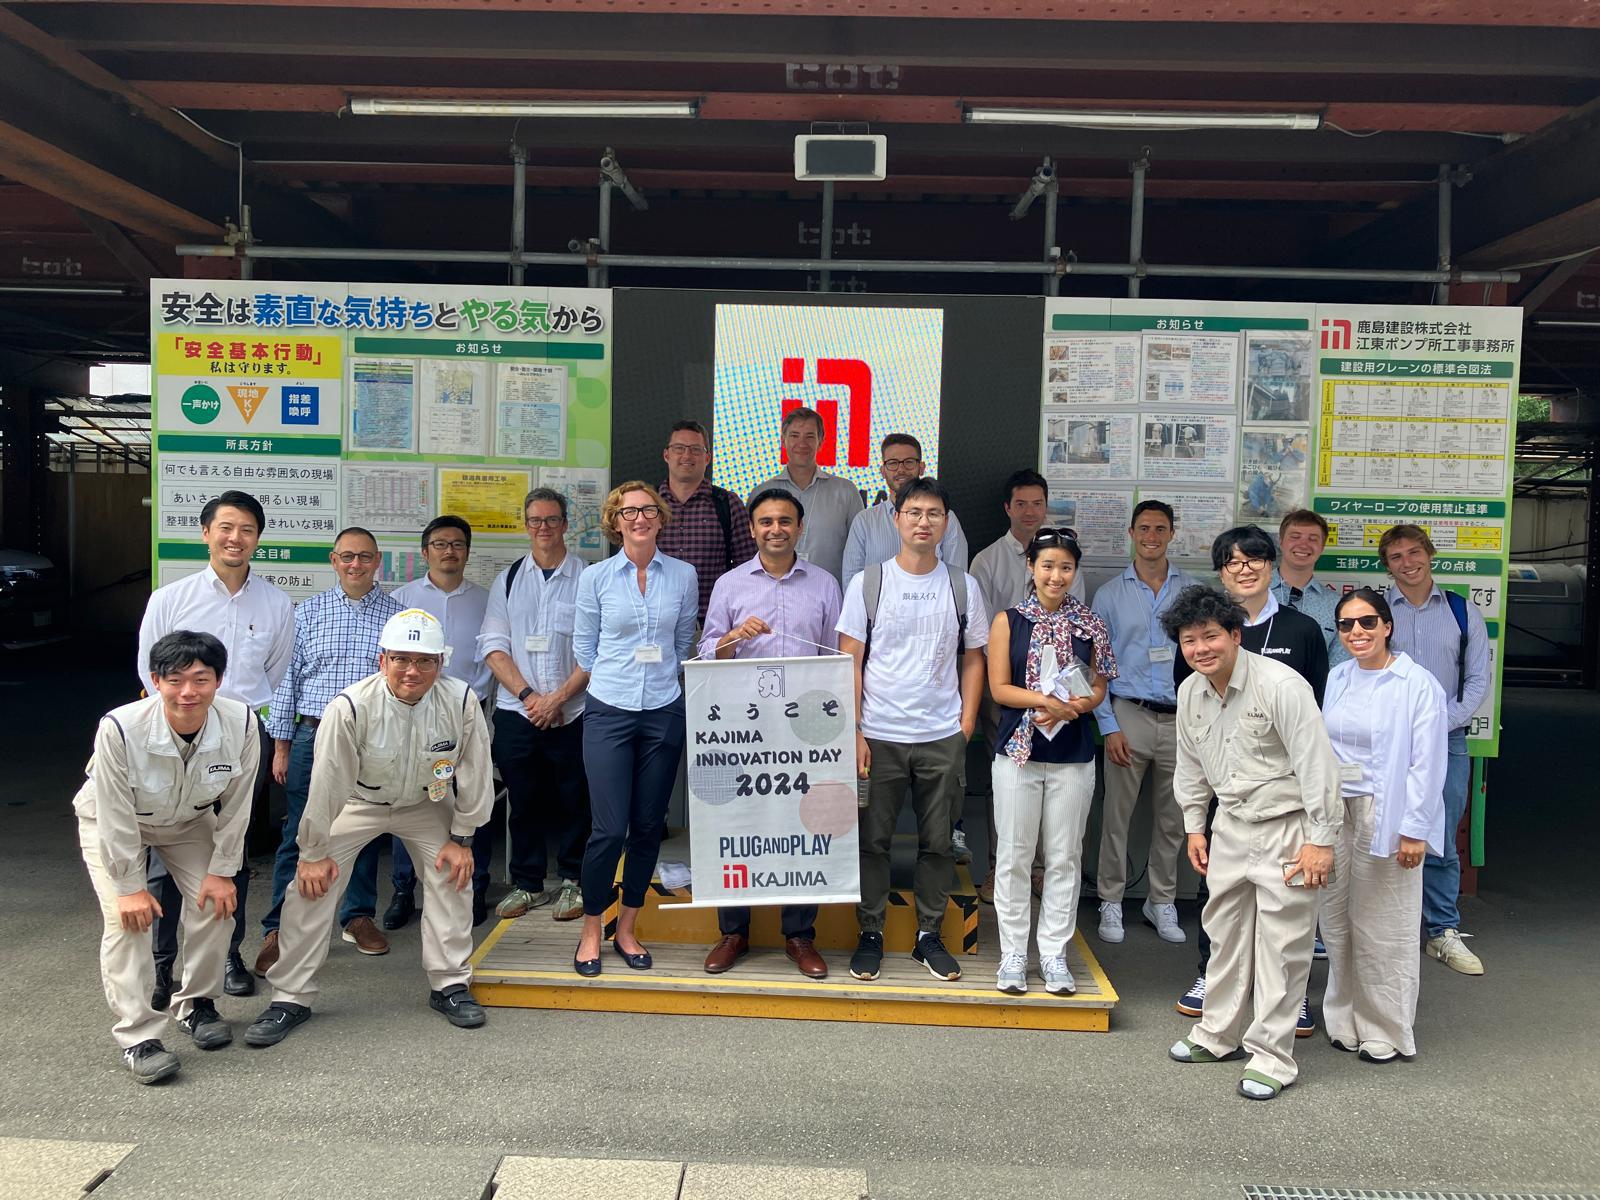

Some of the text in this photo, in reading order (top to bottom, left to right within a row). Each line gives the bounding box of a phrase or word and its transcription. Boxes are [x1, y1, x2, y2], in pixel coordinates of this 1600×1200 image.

[161, 290, 605, 333] 安全は素直な気持ちとやる気から
[1156, 318, 1204, 330] お知らせ
[1357, 320, 1472, 336] 鹿島建設株式会社
[175, 336, 321, 366] 「安全基本行動」
[455, 342, 502, 355] お知らせ
[1356, 336, 1515, 353] 江東ポンプ所工事事務所
[210, 362, 291, 375] 私は守ります。
[1340, 361, 1492, 375] 建設用クレーンの標準合図法
[237, 389, 259, 399] 現地
[182, 399, 220, 410] 一声かけ
[226, 439, 273, 452] 所長方針
[165, 464, 334, 480] 何でも言える自由な雰囲気の現場
[1330, 501, 1488, 515] ワイヤーロープの使用禁止基準
[1336, 557, 1476, 572] 玉掛ワイプの点検
[902, 592, 937, 601] 銀座スイス
[1471, 587, 1496, 606] です
[707, 699, 840, 721] ようこそ
[695, 730, 764, 745] KAJIMA
[696, 749, 842, 767] INNOVATION DAY
[735, 771, 811, 797] 2024
[751, 871, 828, 888] KAJIMA
